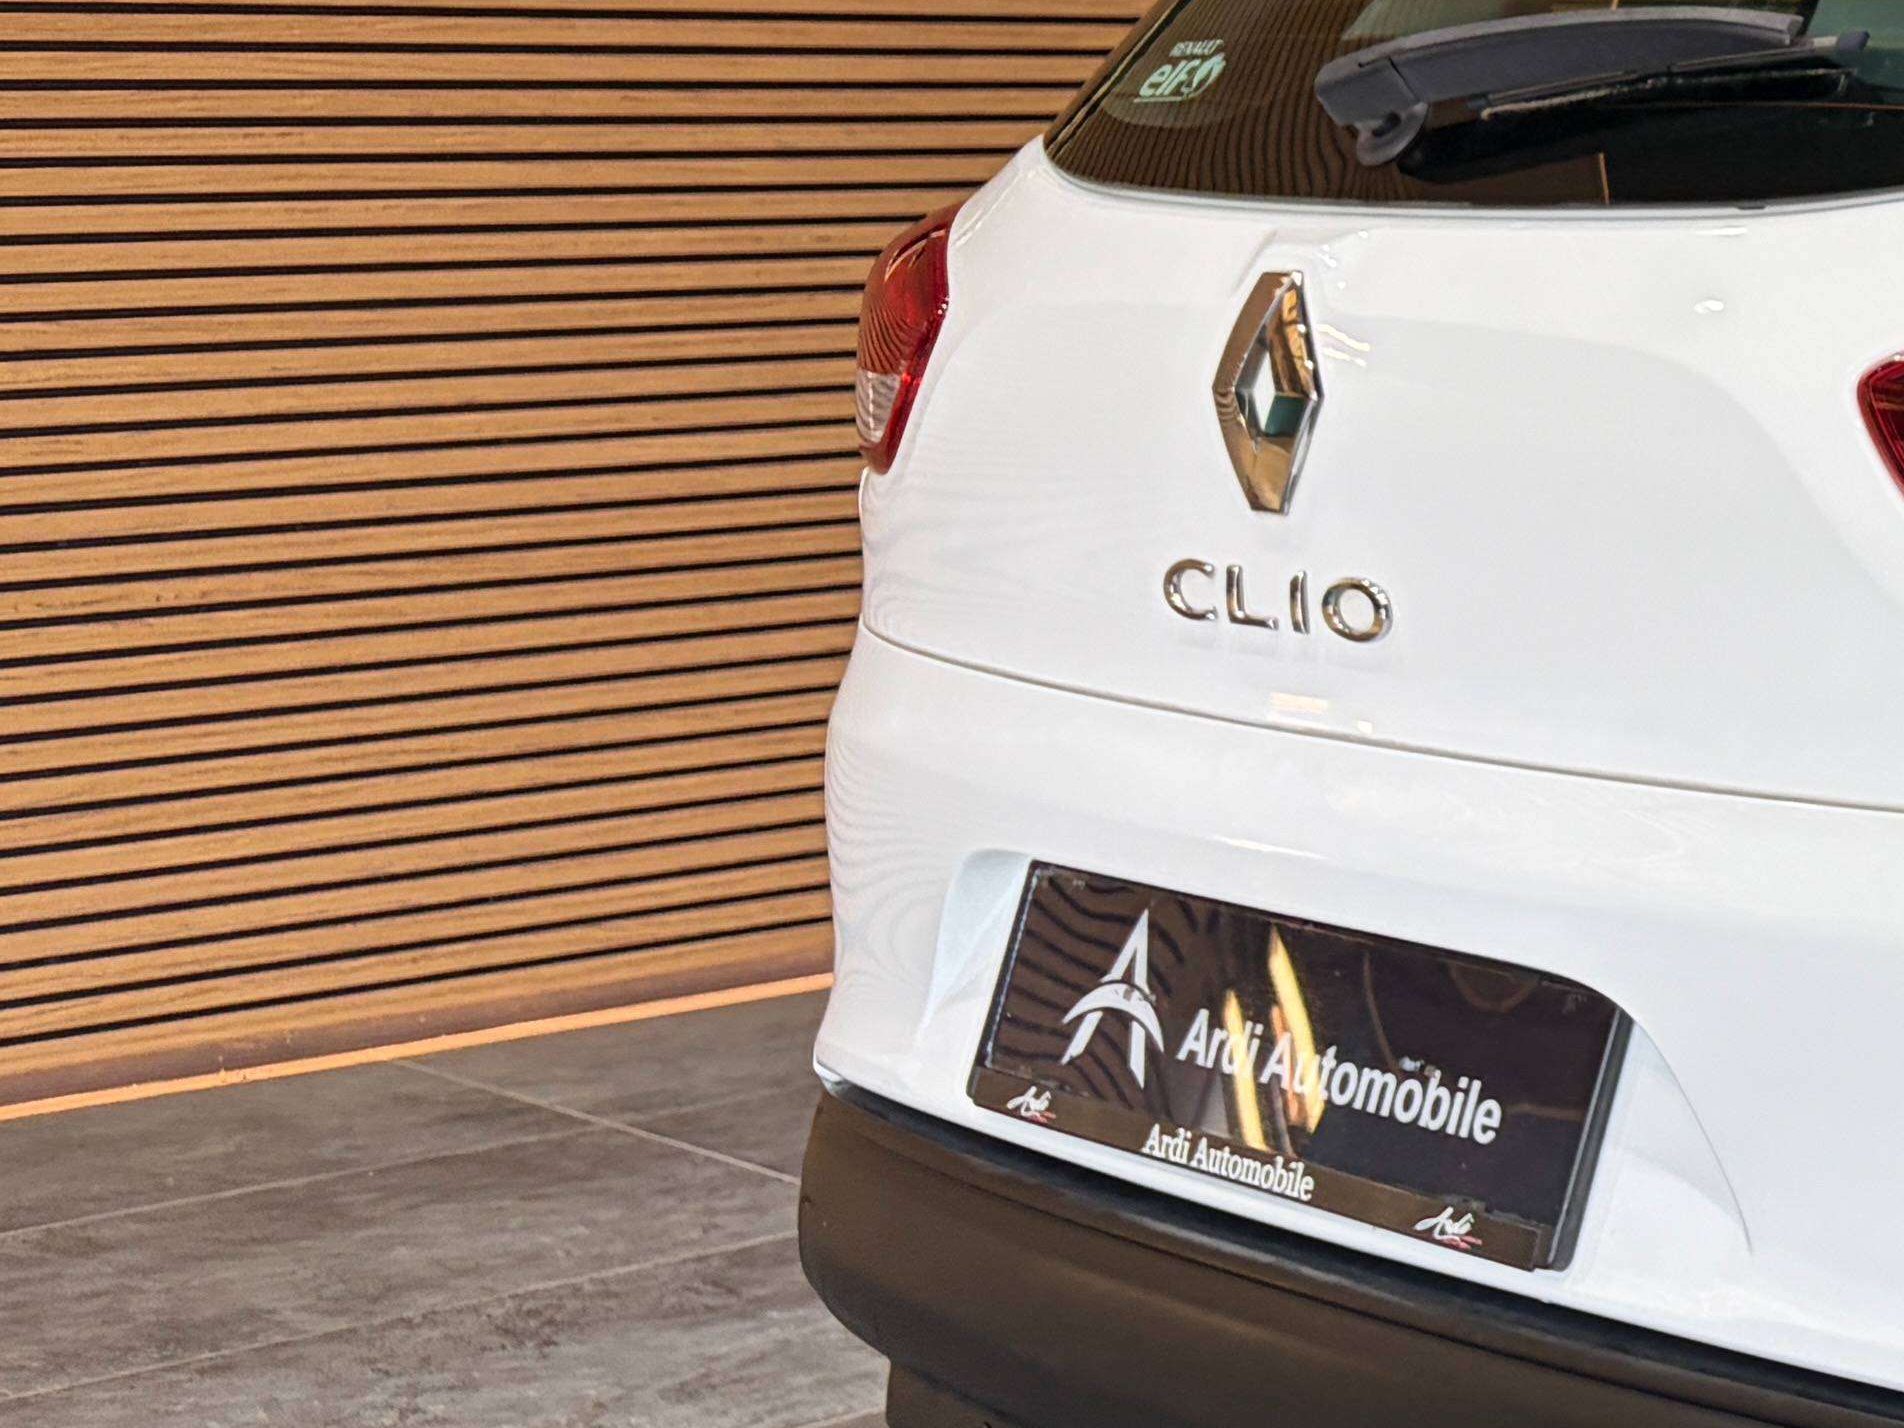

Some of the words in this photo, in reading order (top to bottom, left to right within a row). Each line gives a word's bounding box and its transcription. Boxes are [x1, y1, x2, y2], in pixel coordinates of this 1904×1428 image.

[1163, 558, 1394, 643] CLIO
[1176, 1008, 1264, 1075] Ardi
[1260, 1031, 1503, 1145] Automobile
[1141, 1123, 1193, 1165] Ardi
[1190, 1136, 1315, 1202] Automobile
